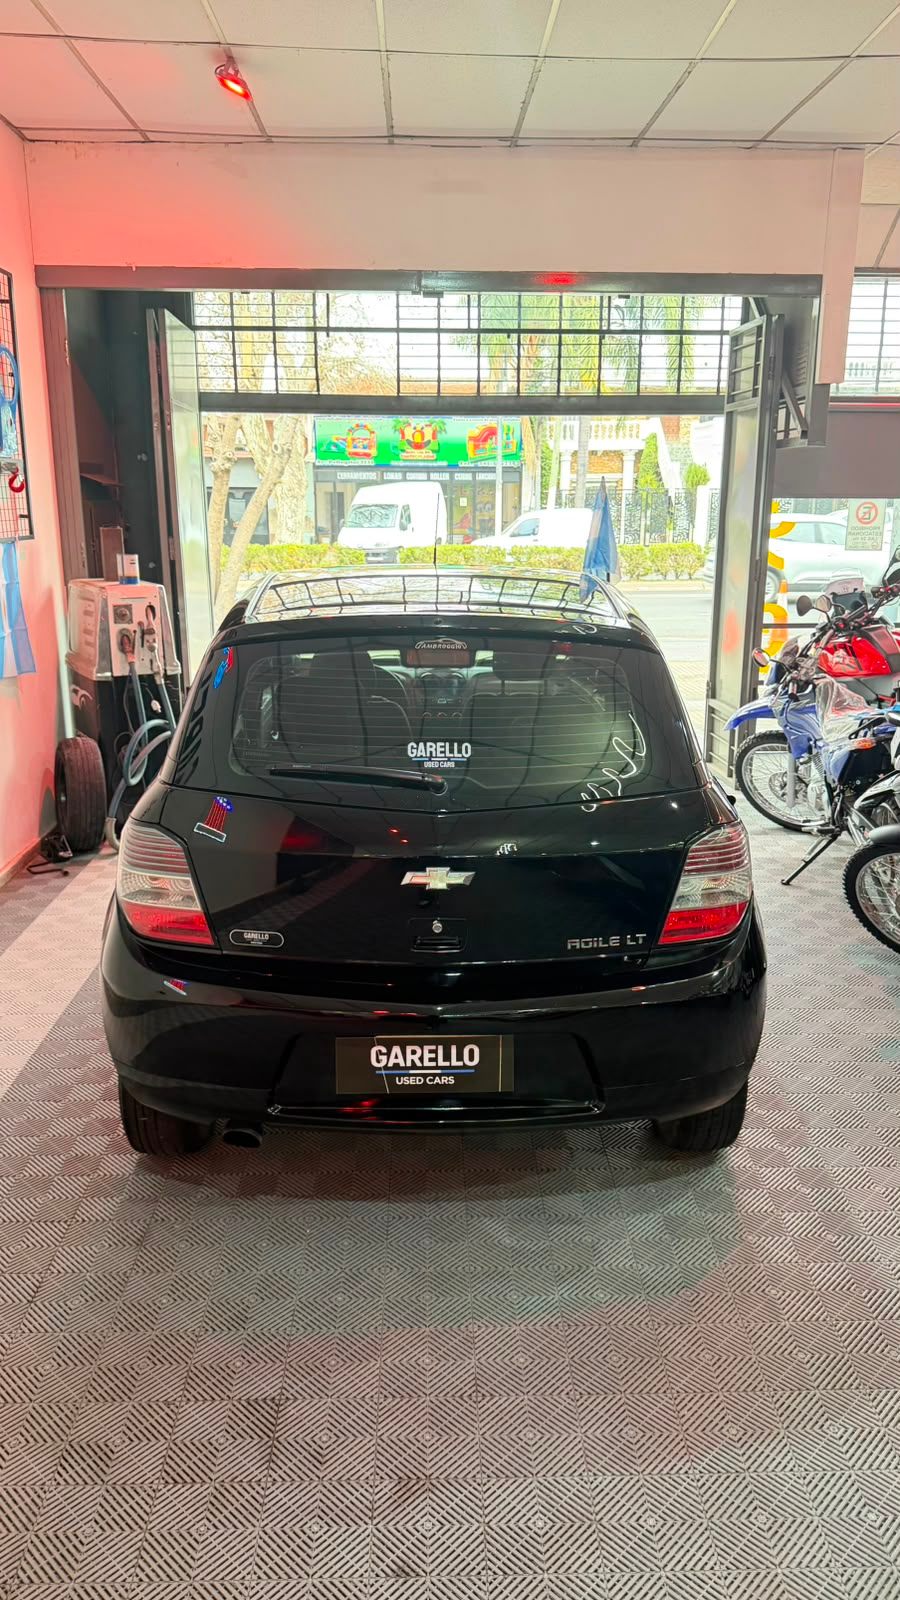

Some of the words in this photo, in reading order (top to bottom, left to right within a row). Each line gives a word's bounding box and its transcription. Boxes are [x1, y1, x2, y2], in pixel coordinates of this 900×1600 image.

[407, 741, 472, 758] GARELLO
[567, 936, 621, 950] AGILE
[626, 933, 647, 945] LT
[370, 1044, 480, 1068] GARELLO
[395, 1077, 424, 1085] USED
[426, 1076, 455, 1085] CARS
